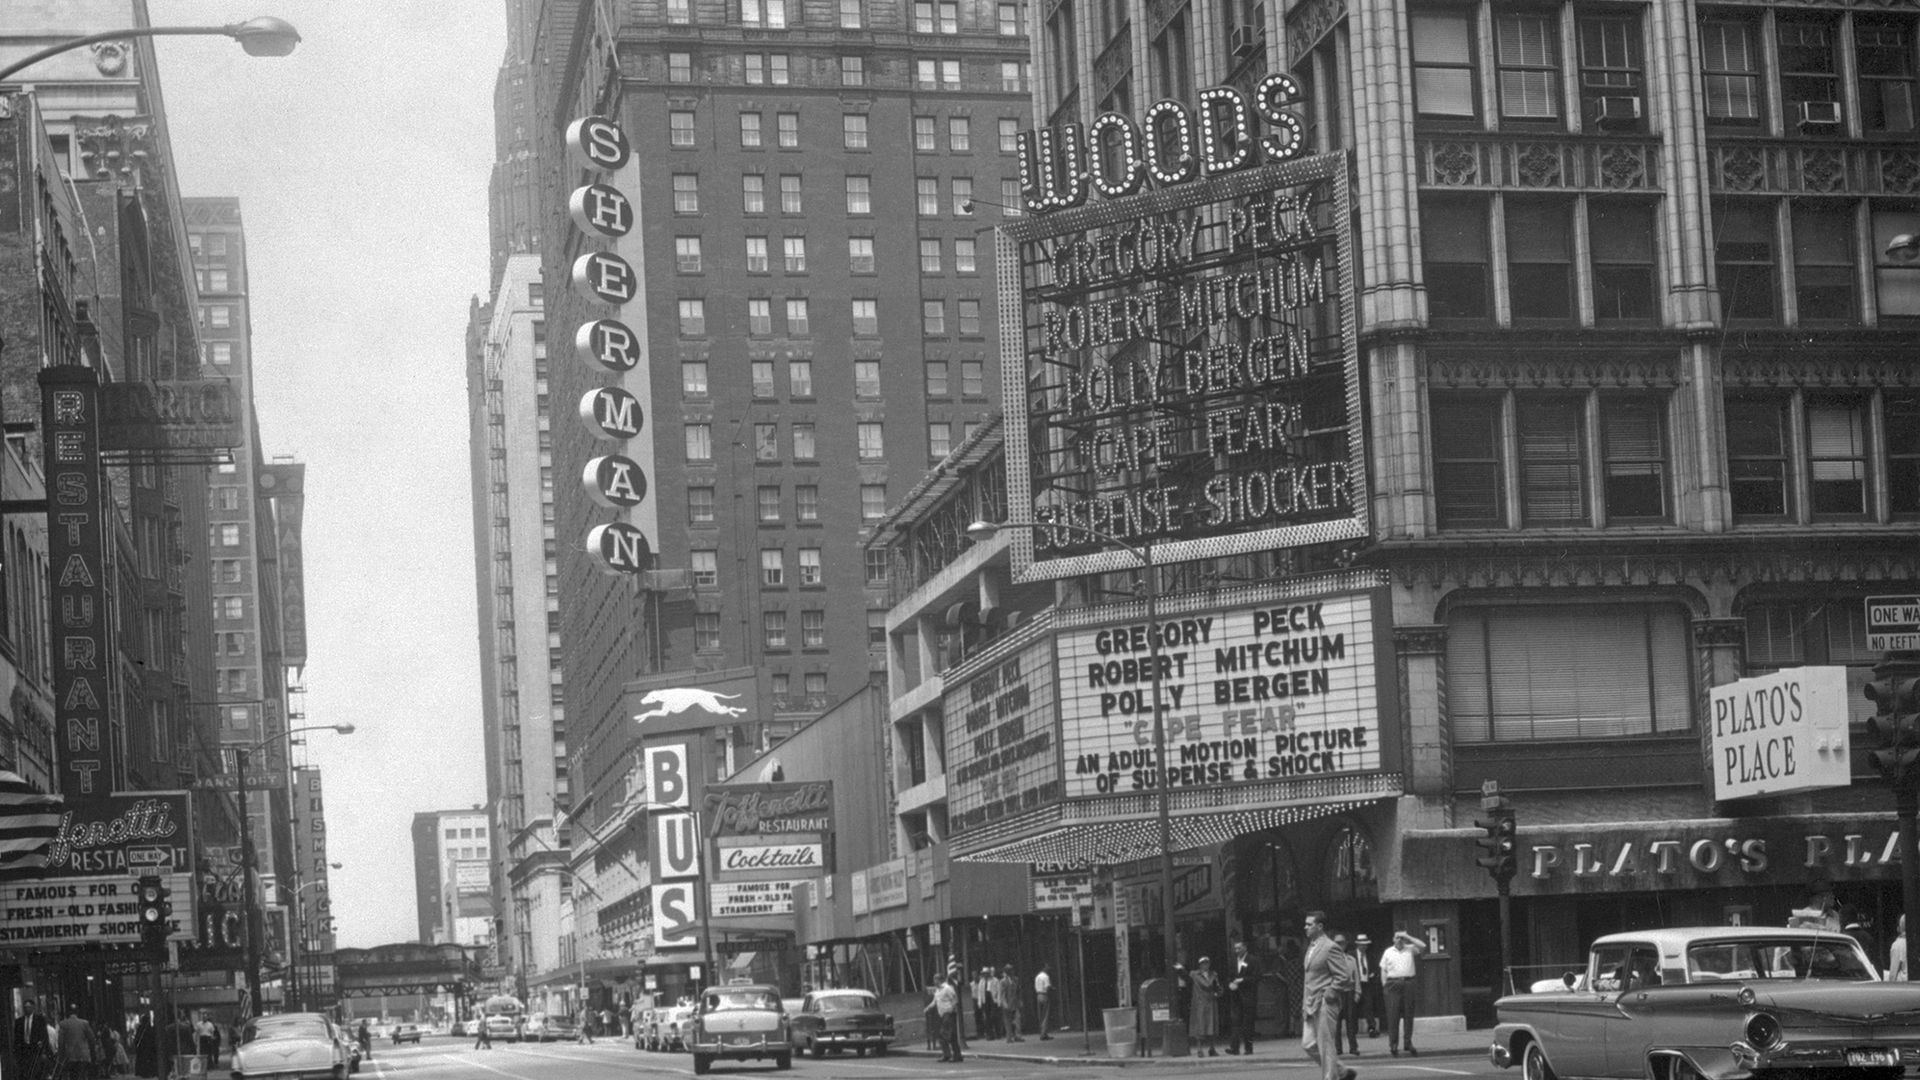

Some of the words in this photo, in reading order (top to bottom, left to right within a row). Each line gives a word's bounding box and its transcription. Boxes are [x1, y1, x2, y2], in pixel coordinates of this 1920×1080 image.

[1016, 73, 1304, 209] WOODS
[1052, 215, 1199, 288] GREGORY
[1228, 193, 1316, 254] PECK
[1045, 290, 1163, 356] ROBERT
[1180, 258, 1324, 330] MITCHUM
[589, 122, 642, 566] SHERMAN
[1067, 352, 1162, 416] POLLY
[1185, 328, 1308, 395] BERGEN
[1080, 421, 1171, 476] "CAPE
[1208, 403, 1301, 458] FEAR"
[1034, 486, 1182, 550] SUSPENSE
[1205, 461, 1351, 526] SHOCKER
[53, 390, 101, 793] RESTAURANT
[1873, 607, 1898, 623] ONE
[1902, 606, 1920, 622] WA
[1095, 617, 1213, 655] GREGORY
[1253, 603, 1325, 637] PECK
[1871, 636, 1886, 650] NO
[1890, 635, 1913, 650] LEFT
[1088, 652, 1188, 688] ROBERT
[1215, 633, 1345, 673] MITCHUM
[1214, 668, 1329, 705] BERGEN
[1715, 681, 1803, 738] PLATO'S
[1076, 753, 1100, 775] AN
[1108, 748, 1158, 772] ADUL
[1180, 737, 1257, 764] MOTION
[1275, 727, 1367, 755] PICTURE
[1096, 772, 1120, 793] OF
[1132, 762, 1233, 790] SUPENSE
[1243, 759, 1258, 780] &
[1268, 752, 1344, 777] SHOCK!
[1725, 735, 1797, 786] PLACE
[46, 799, 177, 867] fenetti
[704, 784, 829, 837] Toffenetti
[759, 817, 829, 833] RESTAURANT
[71, 848, 187, 870] RESTAT
[310, 778, 329, 932] BISMARCK
[652, 749, 694, 942] BUS
[727, 846, 816, 869] Cocktails
[1531, 838, 1768, 880] PLATO'S
[1804, 831, 1904, 867] PLA
[7, 905, 53, 921] FRESH
[68, 904, 94, 917] OLD
[16, 885, 77, 900] FAMOUS
[89, 883, 117, 897] FOR
[720, 904, 773, 914] STRAWBERRY
[737, 883, 770, 892] FAMOUS
[775, 882, 790, 891] FOR
[0, 924, 89, 941] STRAWBERRY
[100, 920, 181, 935] SHORTE
